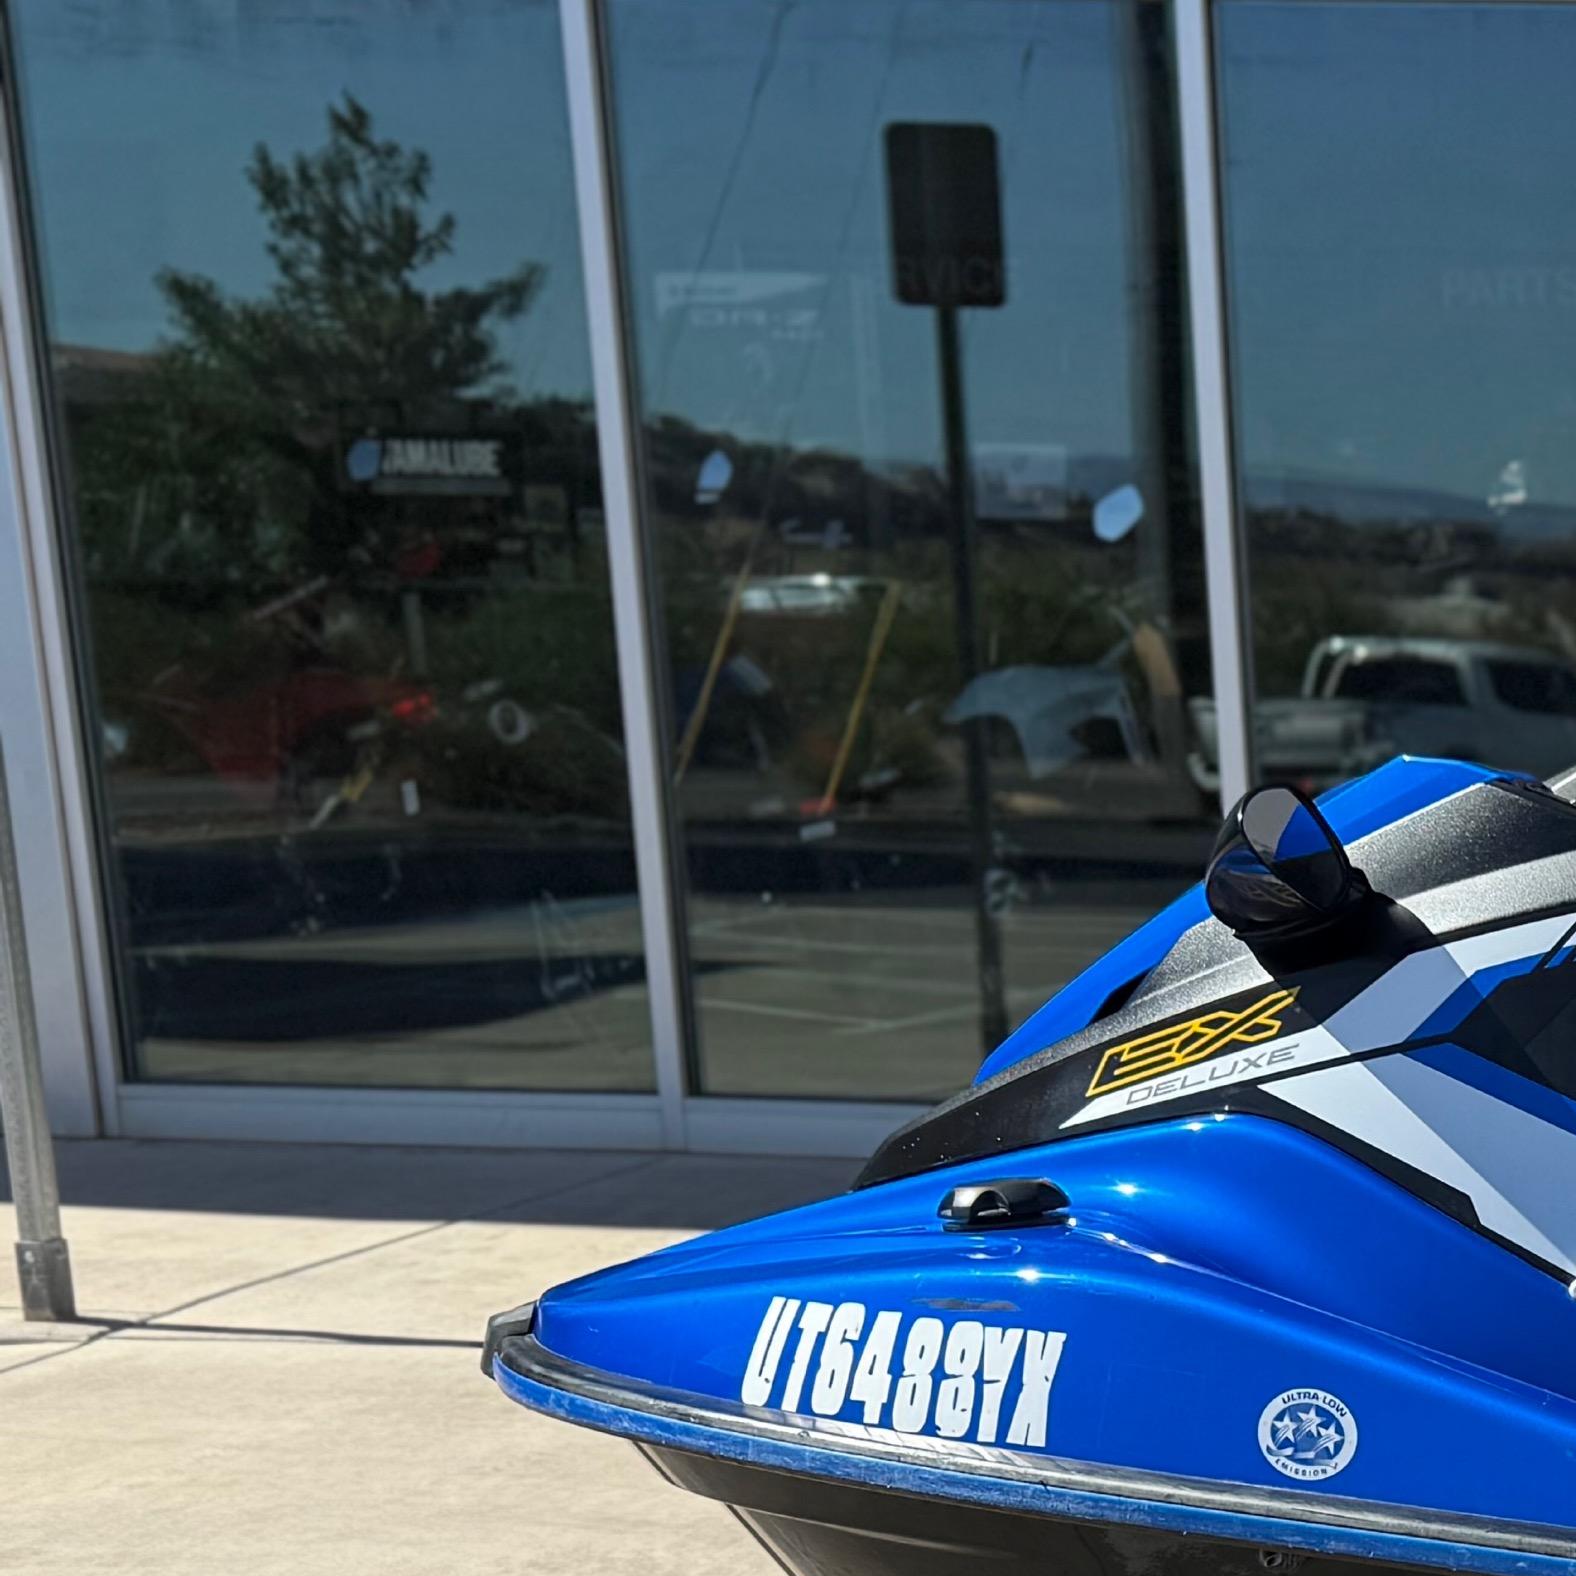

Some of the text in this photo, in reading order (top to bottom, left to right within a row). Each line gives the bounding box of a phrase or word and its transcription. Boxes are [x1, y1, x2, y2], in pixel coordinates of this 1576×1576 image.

[1086, 986, 1301, 1098] EX
[1126, 1043, 1300, 1106] DELUXE
[740, 1296, 1067, 1447] UT6488YX
[1281, 1391, 1347, 1417] ULTRA LOW
[1275, 1458, 1328, 1477] EMISSION
